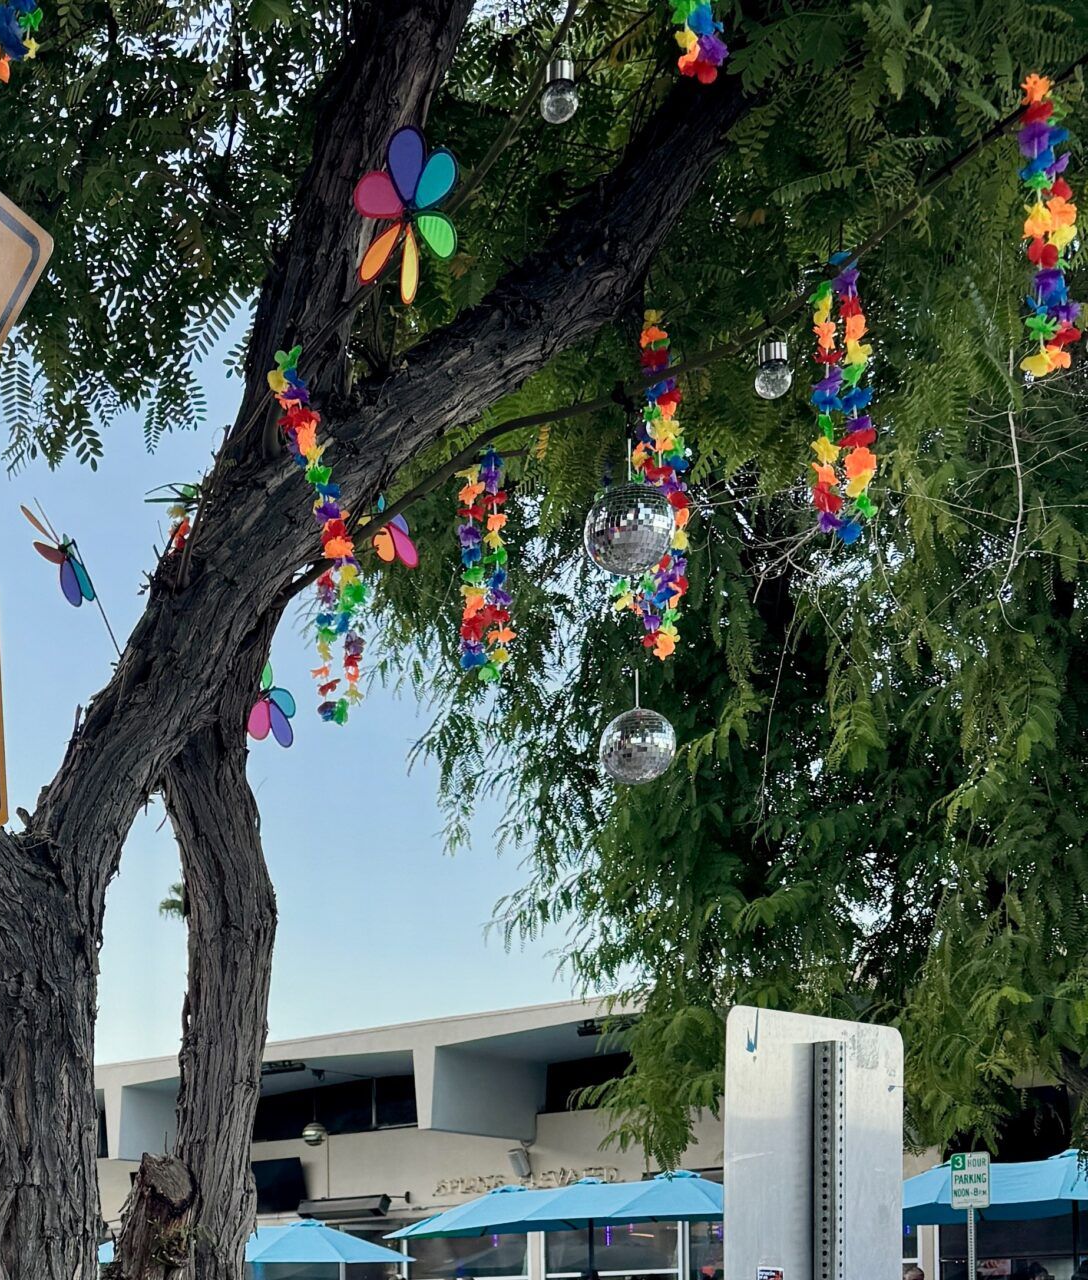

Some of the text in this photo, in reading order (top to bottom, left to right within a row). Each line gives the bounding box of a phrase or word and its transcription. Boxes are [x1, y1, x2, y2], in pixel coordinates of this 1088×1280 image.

[954, 1156, 987, 1169] 3 HOUR
[954, 1173, 987, 1185] PARKING
